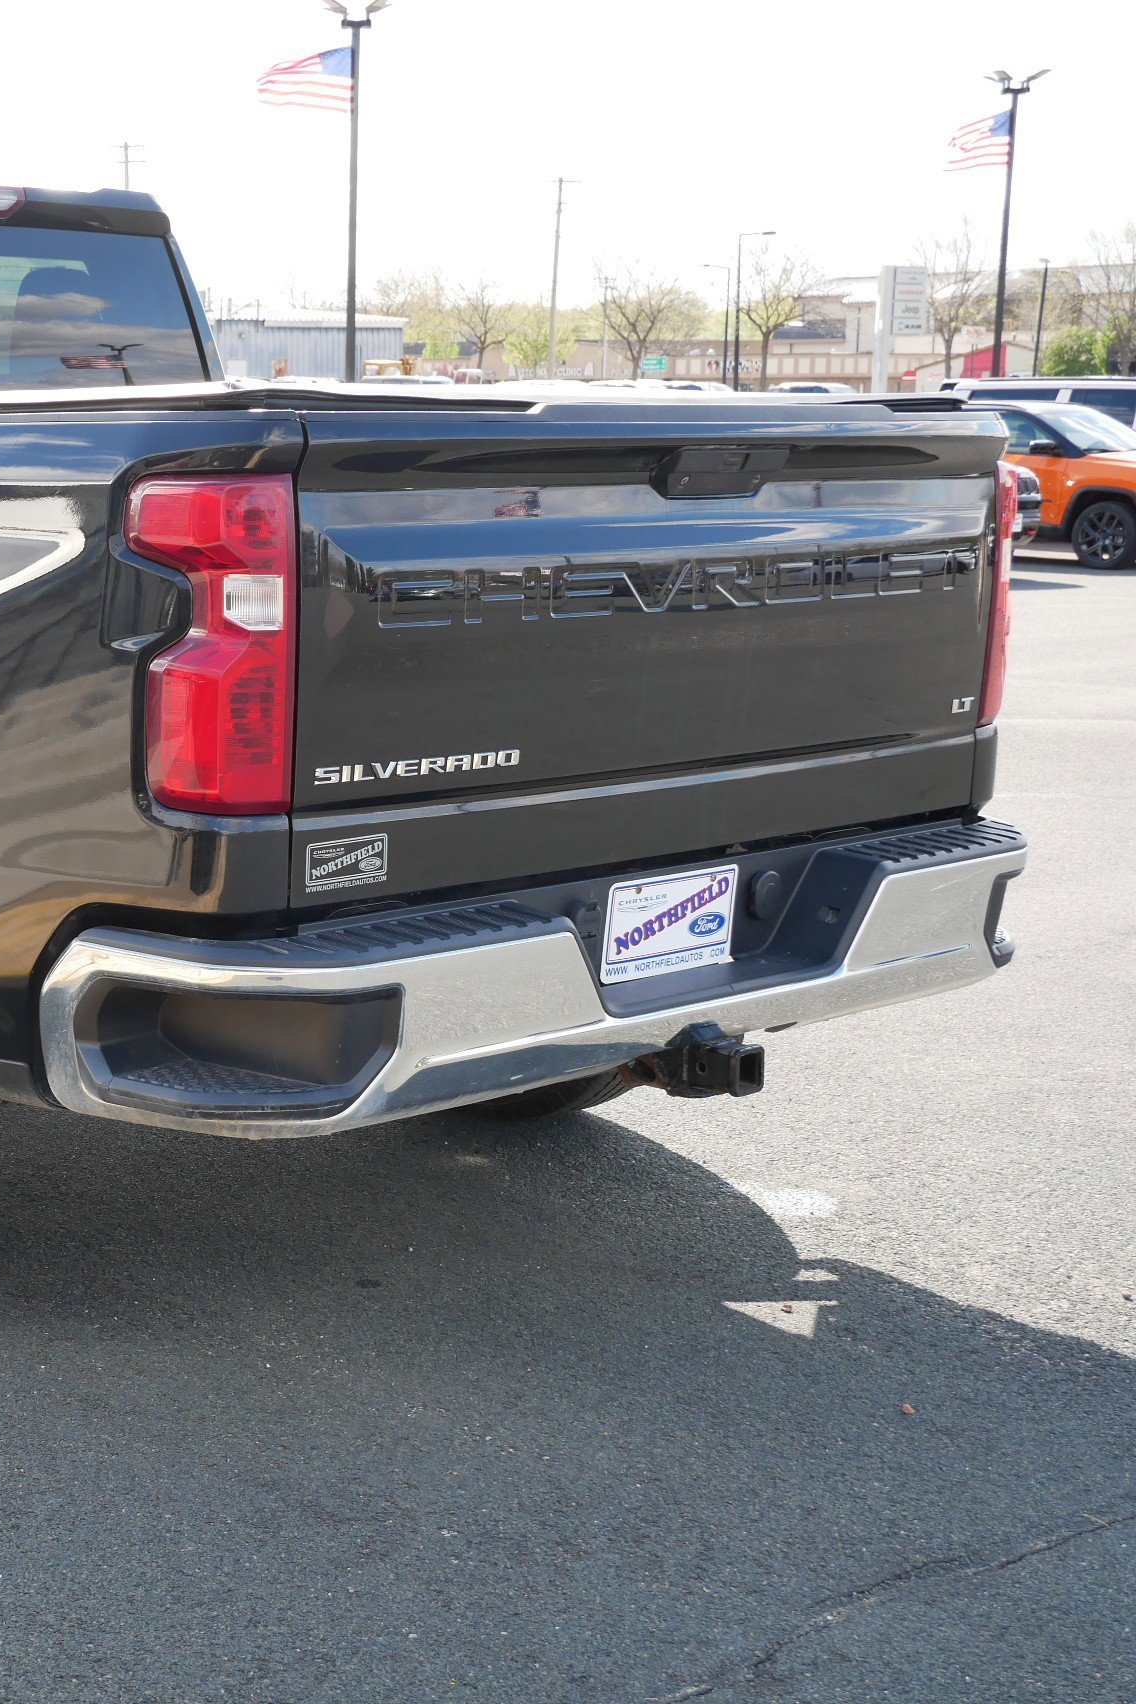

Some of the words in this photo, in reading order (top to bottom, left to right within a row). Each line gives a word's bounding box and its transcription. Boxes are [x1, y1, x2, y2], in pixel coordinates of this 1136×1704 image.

[556, 367, 582, 377] CLINIC
[378, 546, 977, 628] CHEVROLET
[951, 696, 975, 714] LT
[314, 749, 520, 785] SILVERADO
[311, 841, 383, 879] NORTHFIELD
[305, 875, 387, 893] WWW.NORTHFIELDAUTOS.COM
[618, 893, 668, 906] CHRYSLER
[613, 876, 730, 955] NORTHFIELD
[694, 916, 719, 933] Ford
